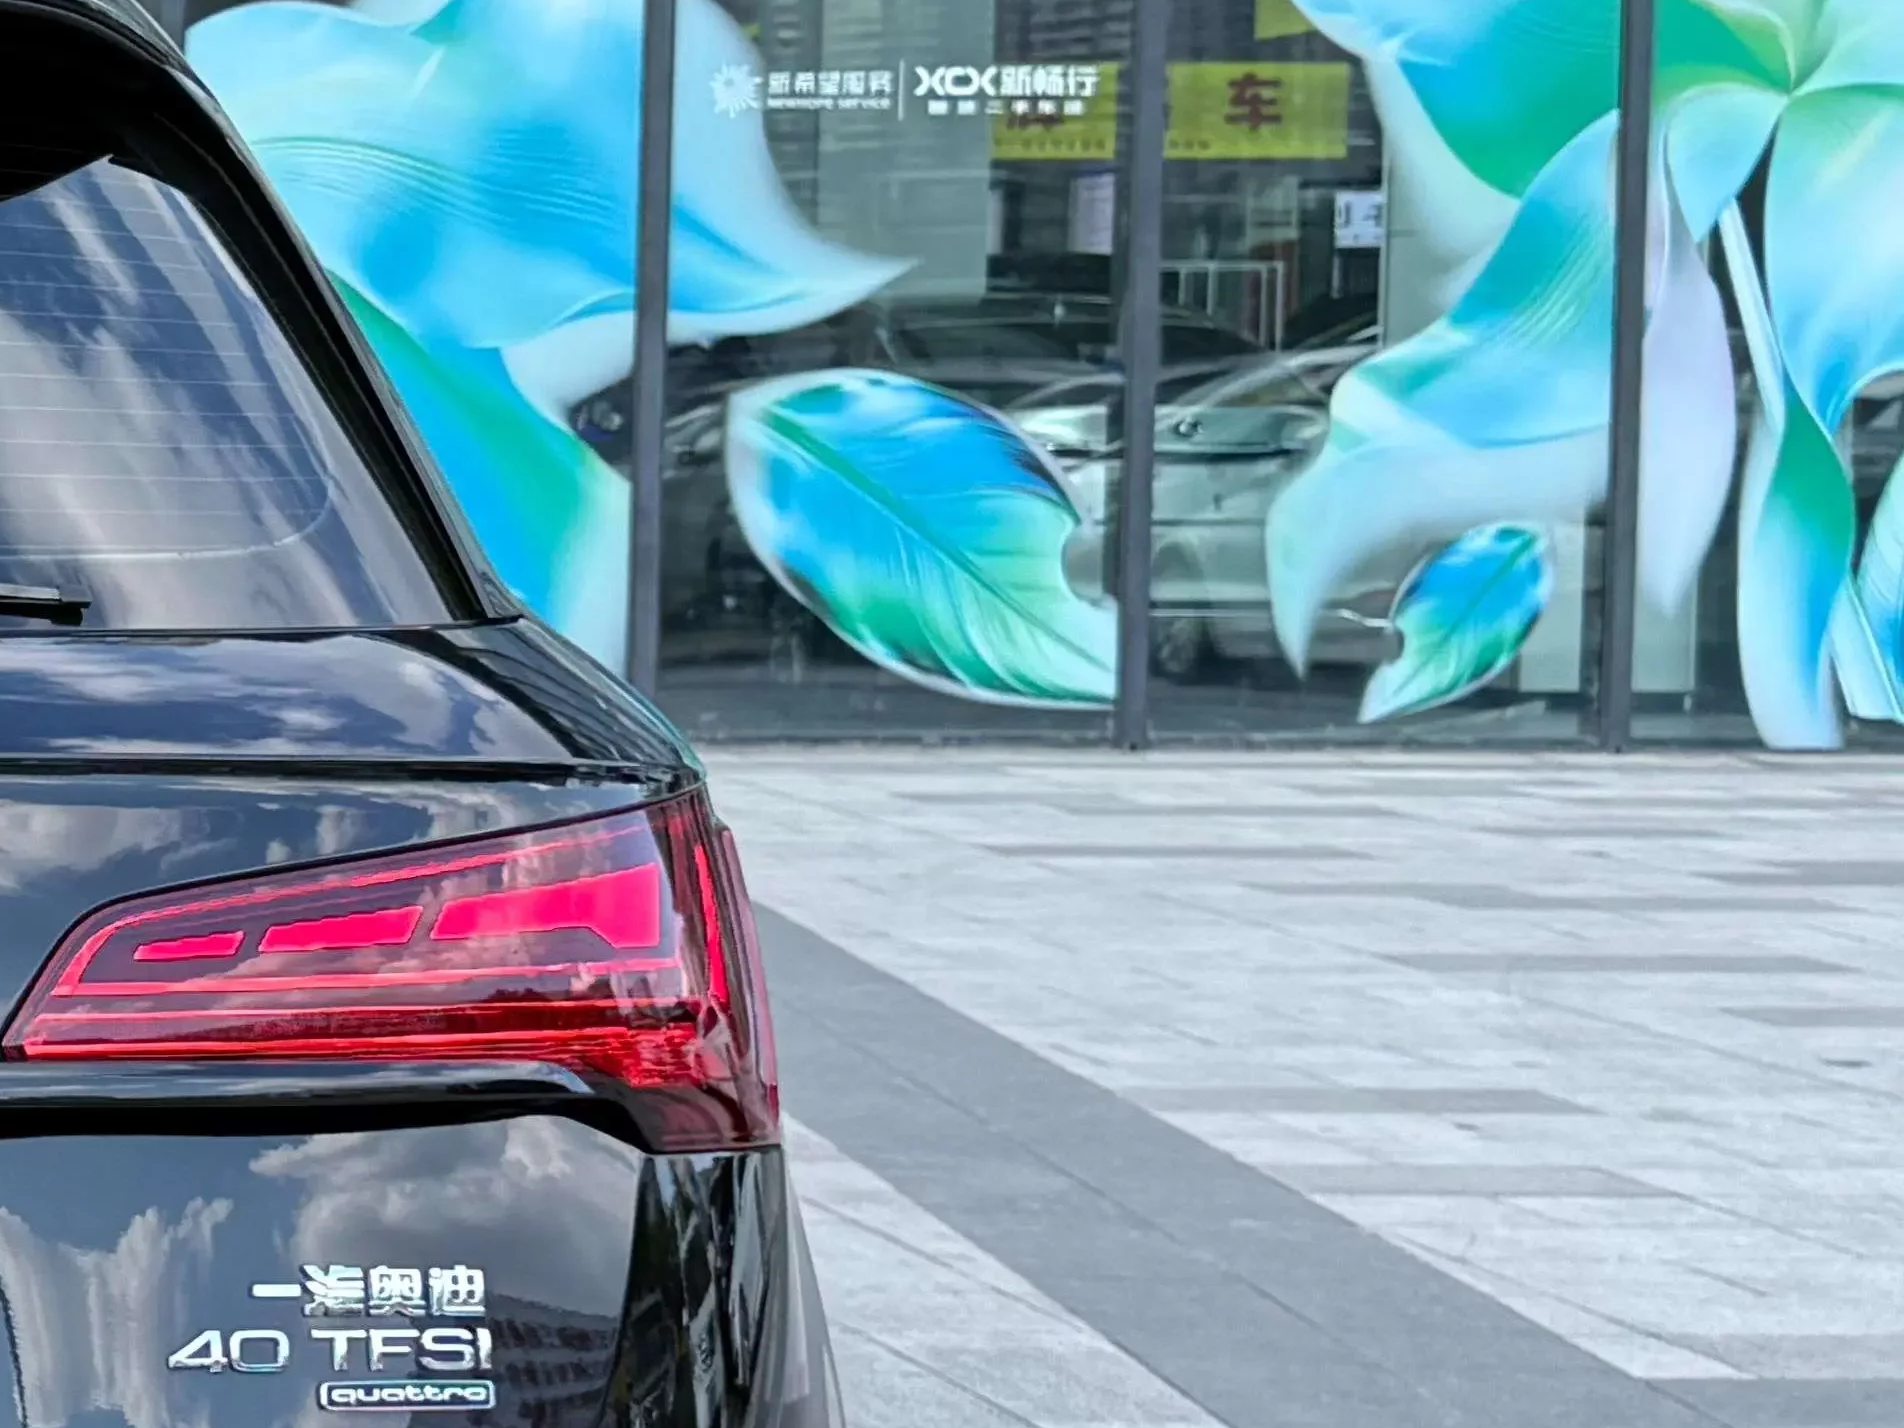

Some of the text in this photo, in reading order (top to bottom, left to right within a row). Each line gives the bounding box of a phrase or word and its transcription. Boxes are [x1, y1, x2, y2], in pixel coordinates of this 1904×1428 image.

[167, 1327, 494, 1373] 40 TFSI
[328, 1384, 489, 1406] quattro
